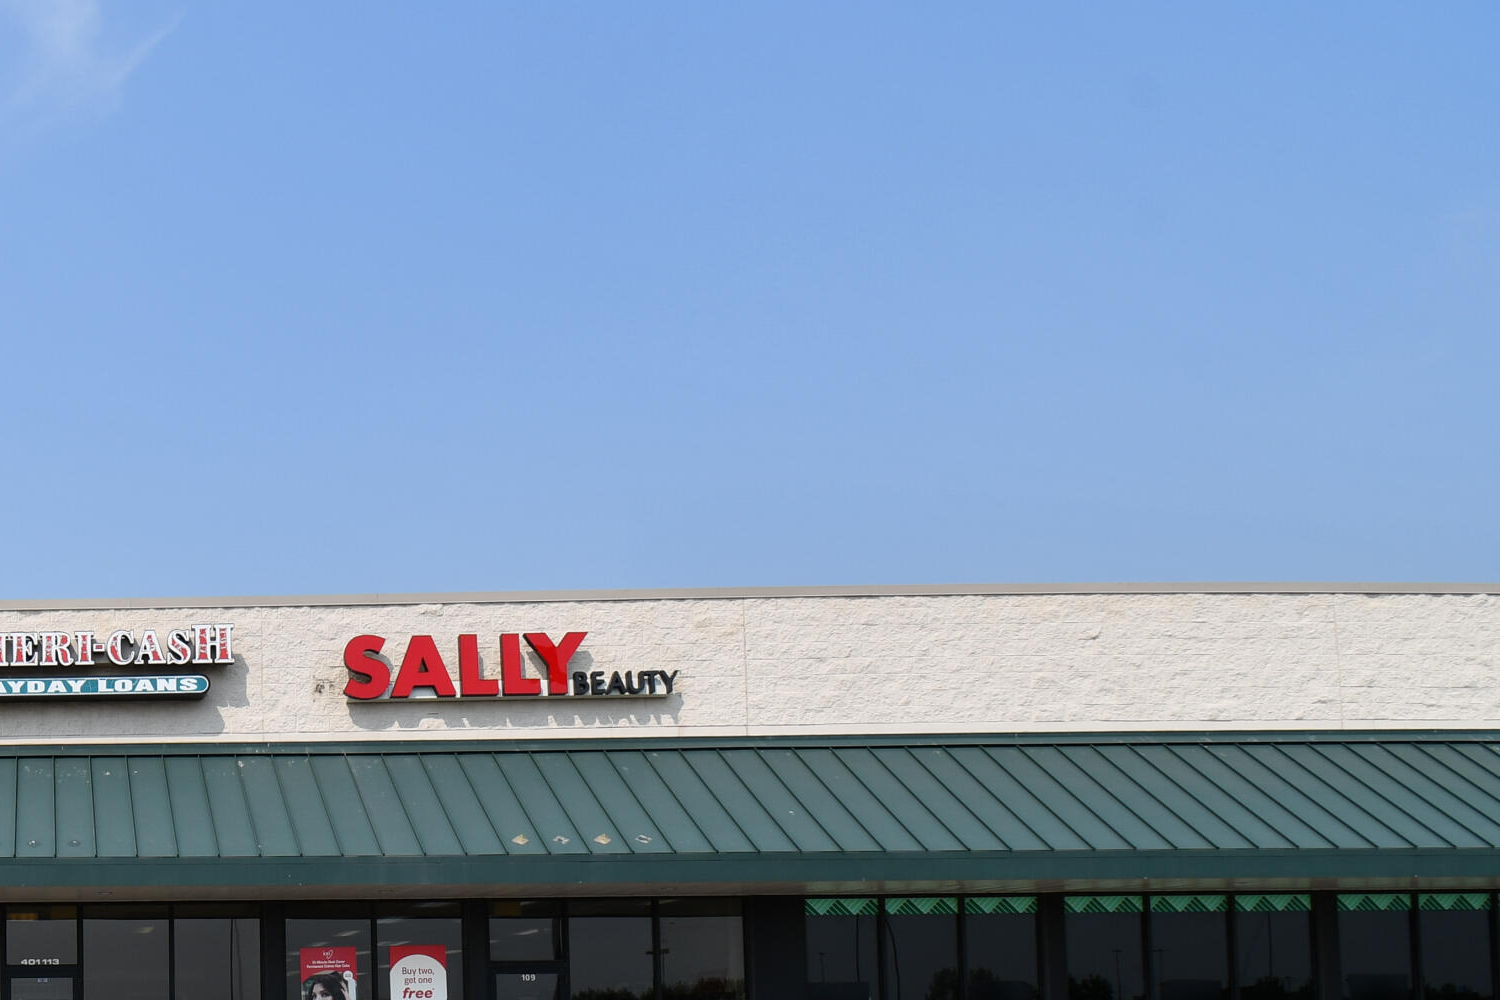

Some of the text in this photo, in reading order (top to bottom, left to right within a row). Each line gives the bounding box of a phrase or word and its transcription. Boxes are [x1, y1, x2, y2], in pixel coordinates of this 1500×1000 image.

[343, 631, 680, 699] SALLY BEAUTY
[96, 676, 198, 693] LOANS
[401, 967, 435, 976] Buy two,
[404, 976, 417, 985] get
[521, 973, 536, 982] 109
